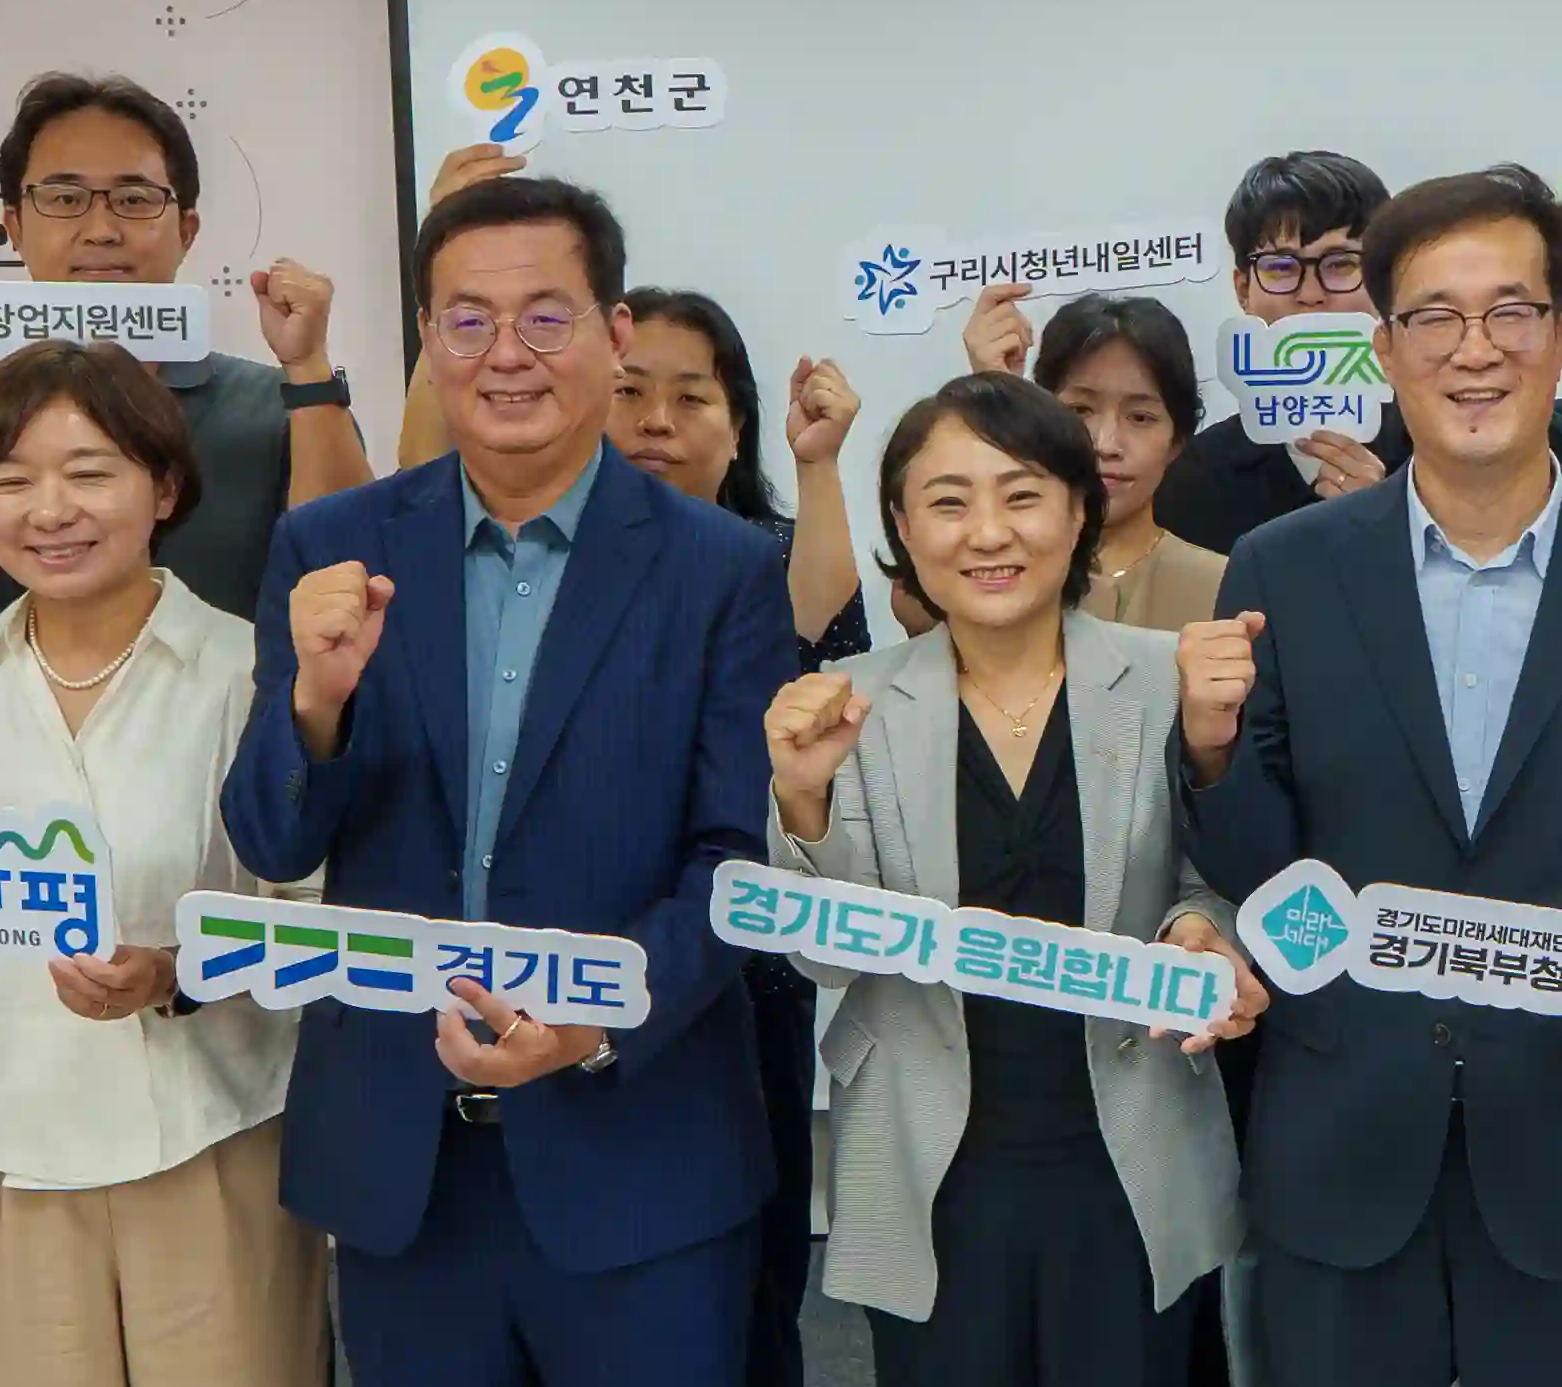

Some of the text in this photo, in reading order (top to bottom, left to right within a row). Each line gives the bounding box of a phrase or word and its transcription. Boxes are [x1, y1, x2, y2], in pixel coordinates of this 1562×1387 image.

[558, 73, 711, 115] 연천군
[929, 233, 1204, 290] 구리시청년내일센터
[1255, 394, 1363, 426] 남양주시
[437, 943, 626, 1009] 경기도
[727, 878, 1219, 1019] 경기도가 응원합니다
